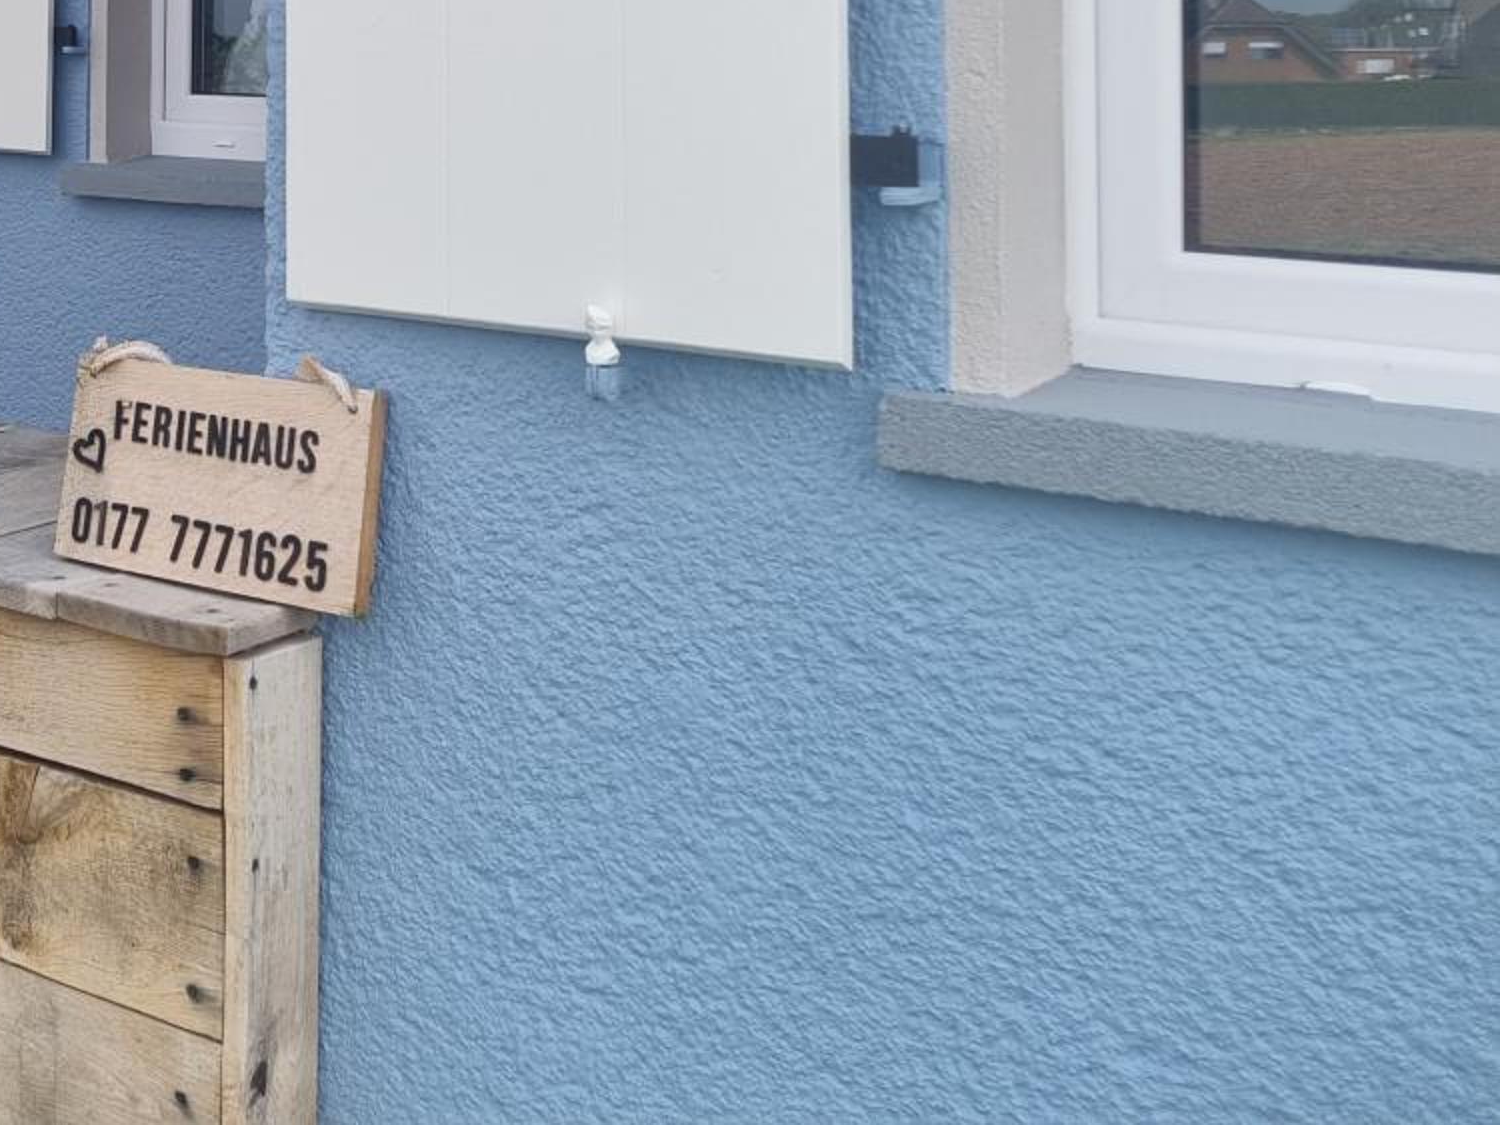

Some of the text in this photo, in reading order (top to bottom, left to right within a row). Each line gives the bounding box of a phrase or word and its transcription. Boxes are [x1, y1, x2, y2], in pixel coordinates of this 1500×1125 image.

[113, 400, 320, 474] FERIENHAUS
[71, 497, 329, 592] 0177 7771625
